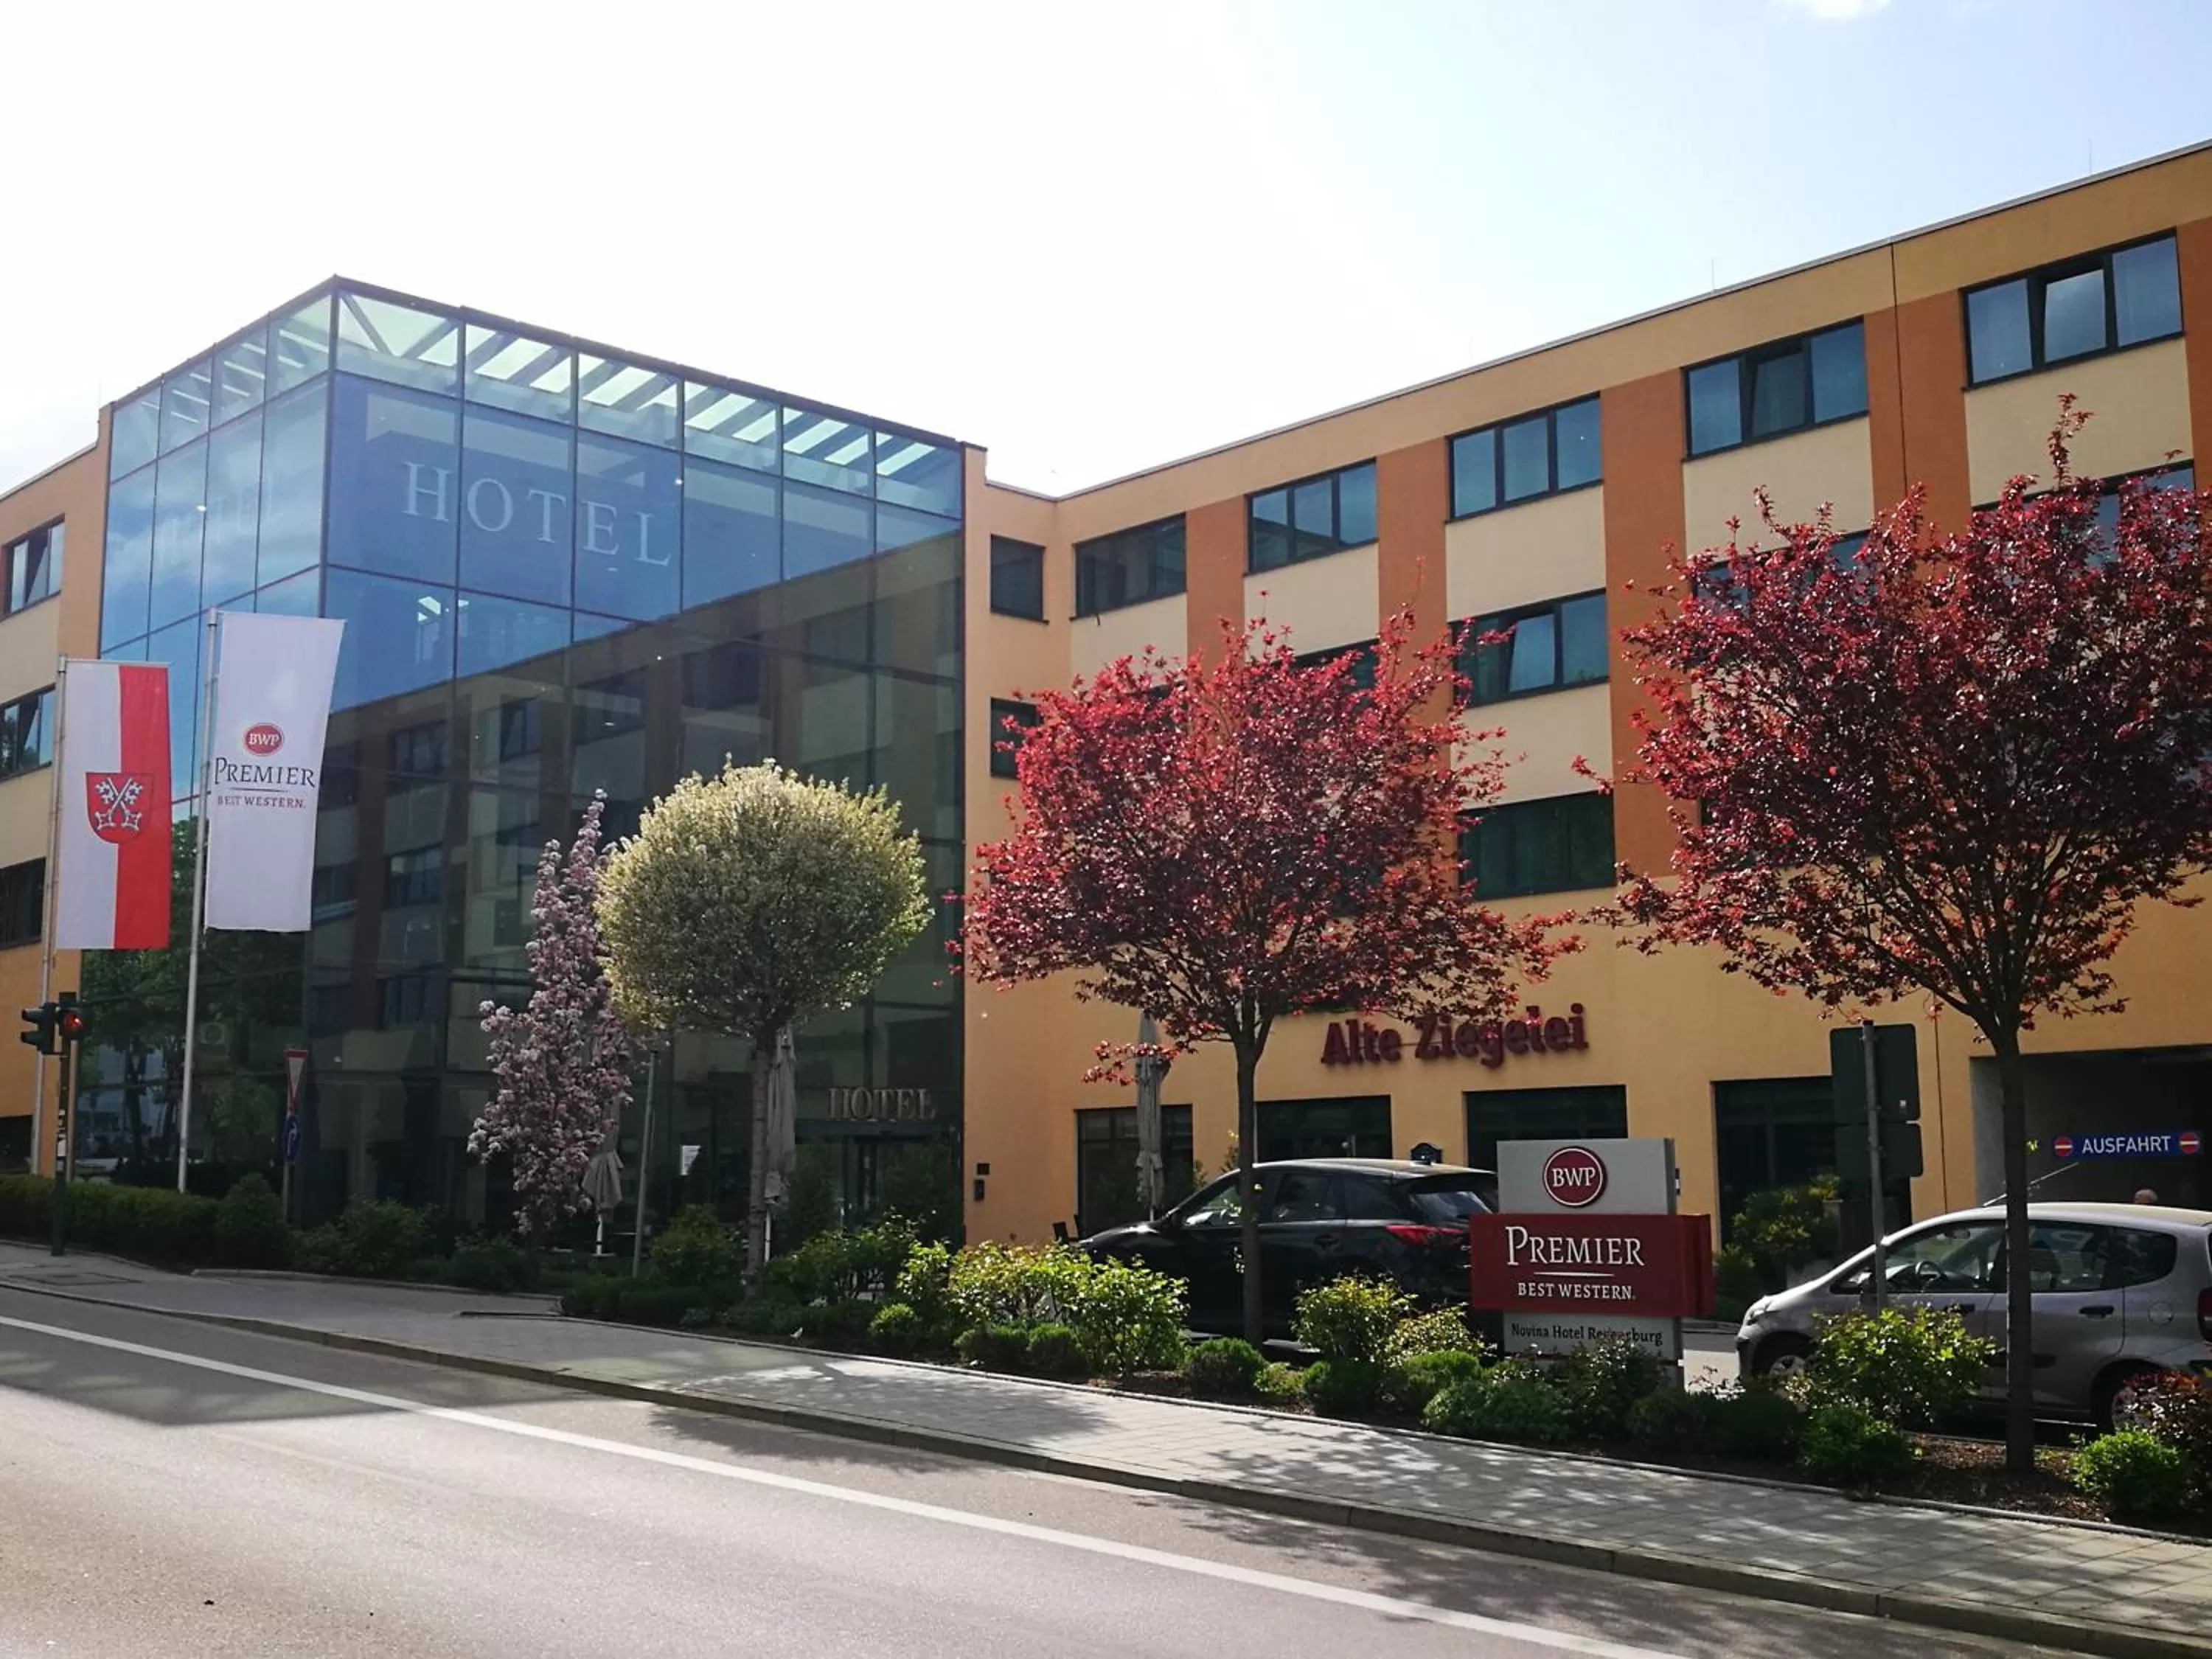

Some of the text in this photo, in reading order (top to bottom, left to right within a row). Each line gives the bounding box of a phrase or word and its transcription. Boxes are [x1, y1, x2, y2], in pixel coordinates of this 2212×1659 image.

[402, 462, 672, 567] HOTEL
[248, 733, 279, 746] BWP
[215, 757, 315, 788] PREMIER
[1321, 1003, 1588, 1068] Alte Ziegelei
[827, 1087, 936, 1121] HOTEL
[2081, 1135, 2171, 1155] AUSFAHRT
[1552, 1166, 1596, 1187] BWP
[1505, 1225, 1645, 1267] PREMIER
[1517, 1281, 1554, 1297] BEST
[1512, 1324, 1663, 1346] Novina Hotel Resburg
